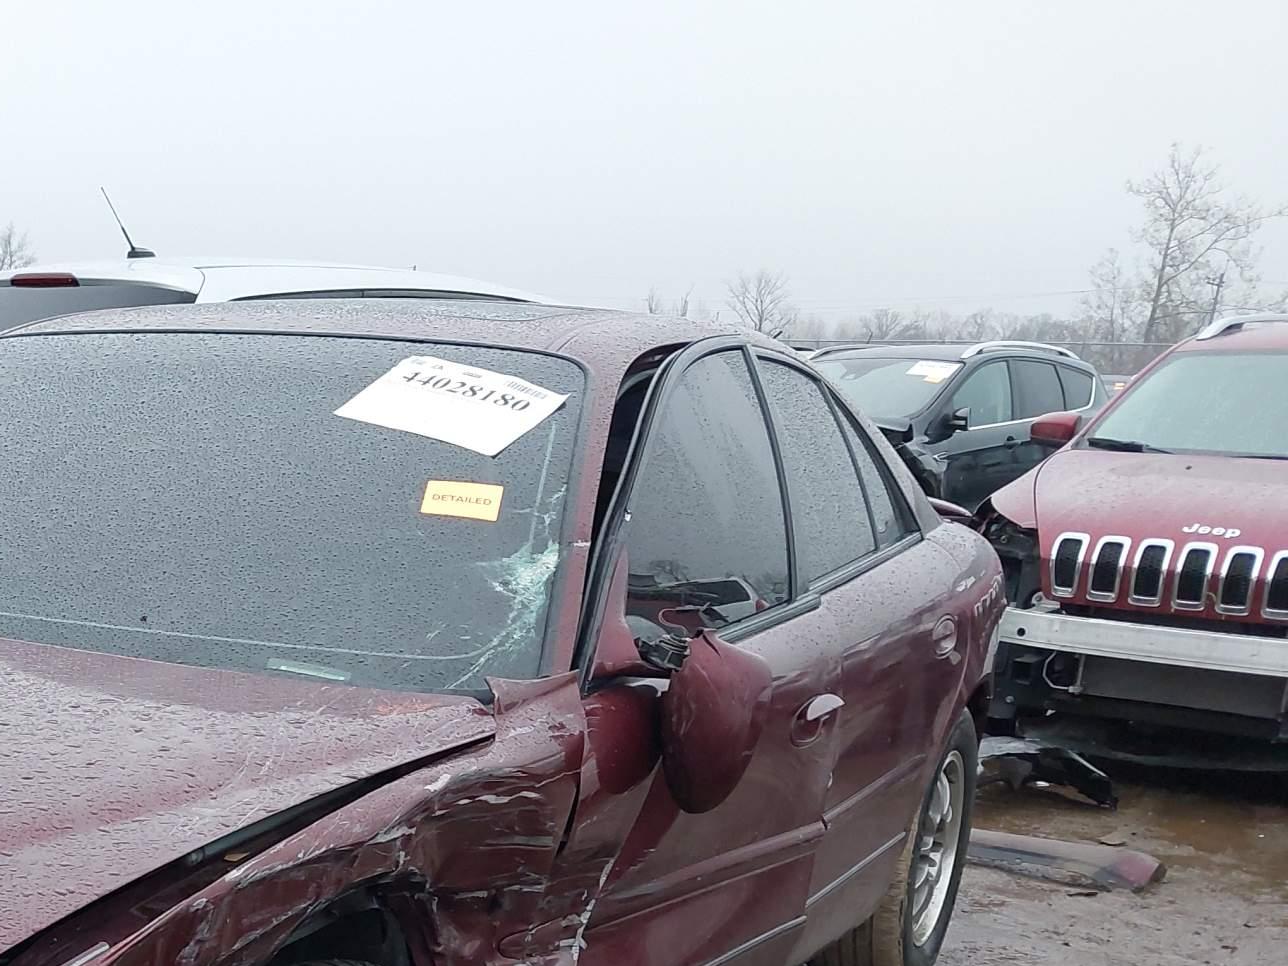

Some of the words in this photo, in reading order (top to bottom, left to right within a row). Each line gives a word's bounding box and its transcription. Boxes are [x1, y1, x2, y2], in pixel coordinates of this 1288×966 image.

[402, 371, 531, 411] 44028180
[431, 493, 492, 507] DETAILED
[1183, 523, 1241, 538] Jeep
